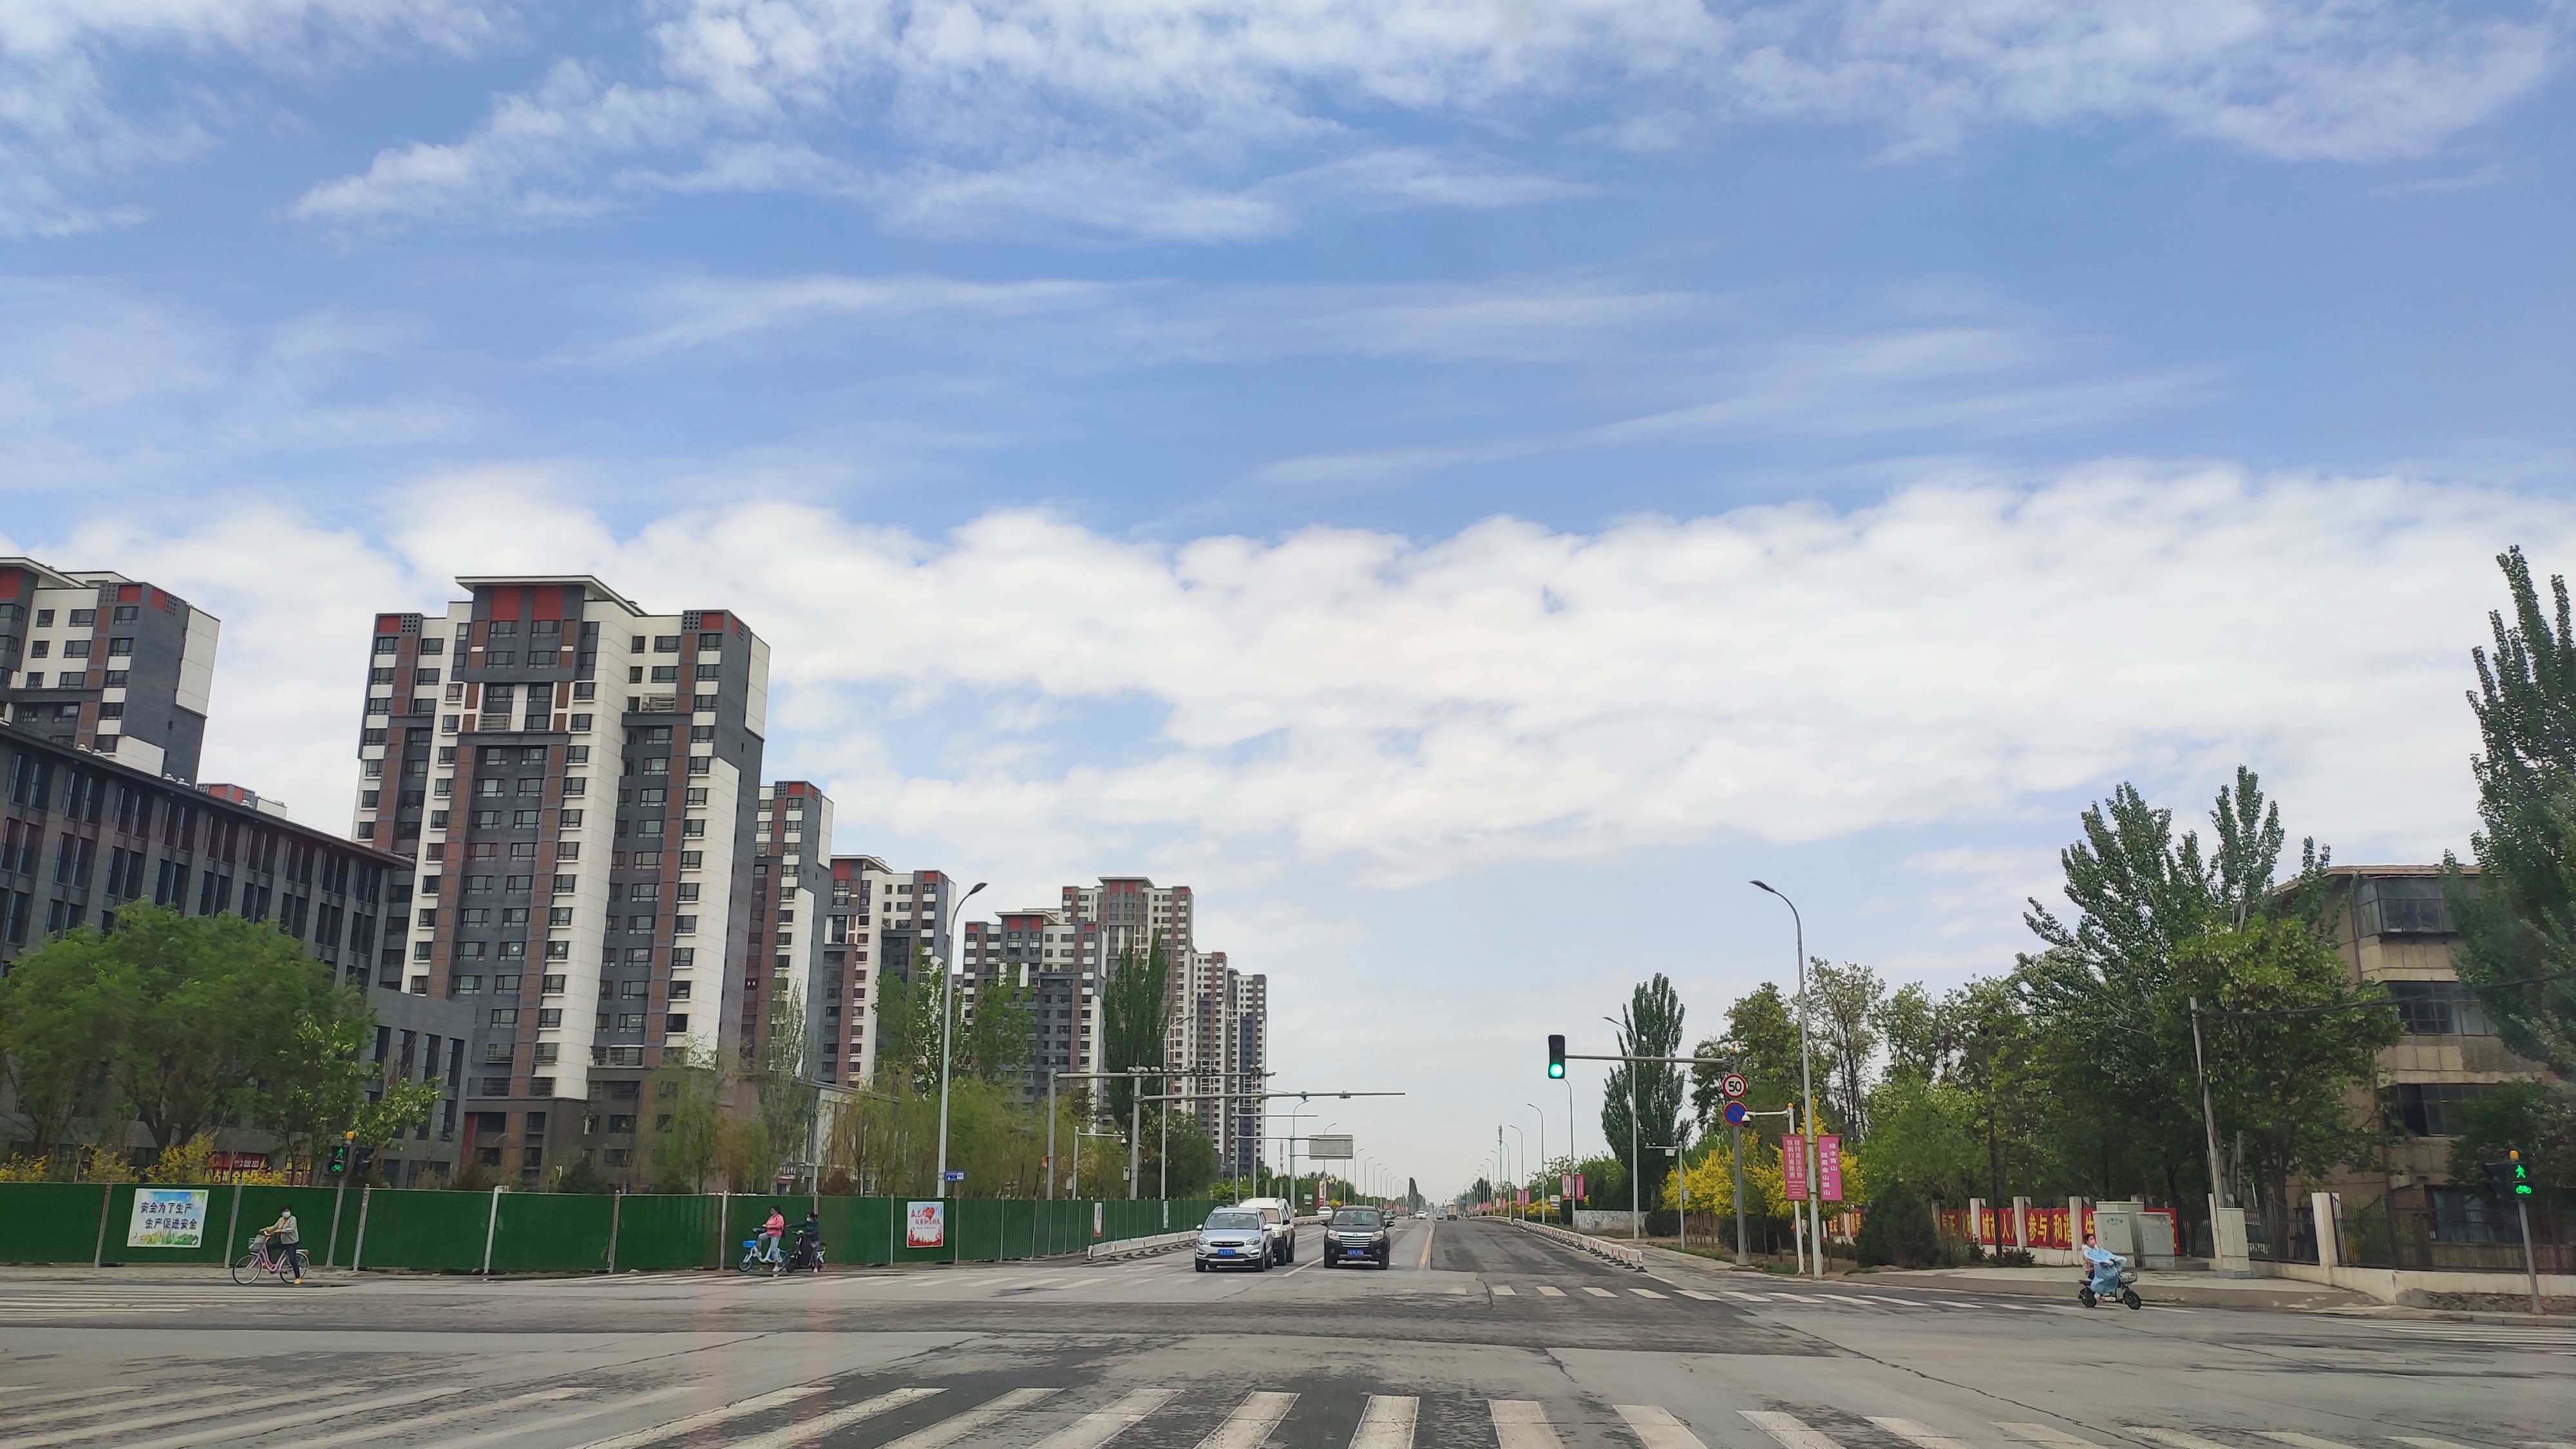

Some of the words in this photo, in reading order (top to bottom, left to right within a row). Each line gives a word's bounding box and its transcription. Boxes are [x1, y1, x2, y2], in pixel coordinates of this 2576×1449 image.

[1728, 1081, 1741, 1092] 50
[1829, 1142, 1837, 1171] 绿水青山
[1821, 1152, 1830, 1195] 就是金山银山
[140, 1200, 193, 1216] 安全为了生产
[145, 1217, 197, 1230] 生产促进安全
